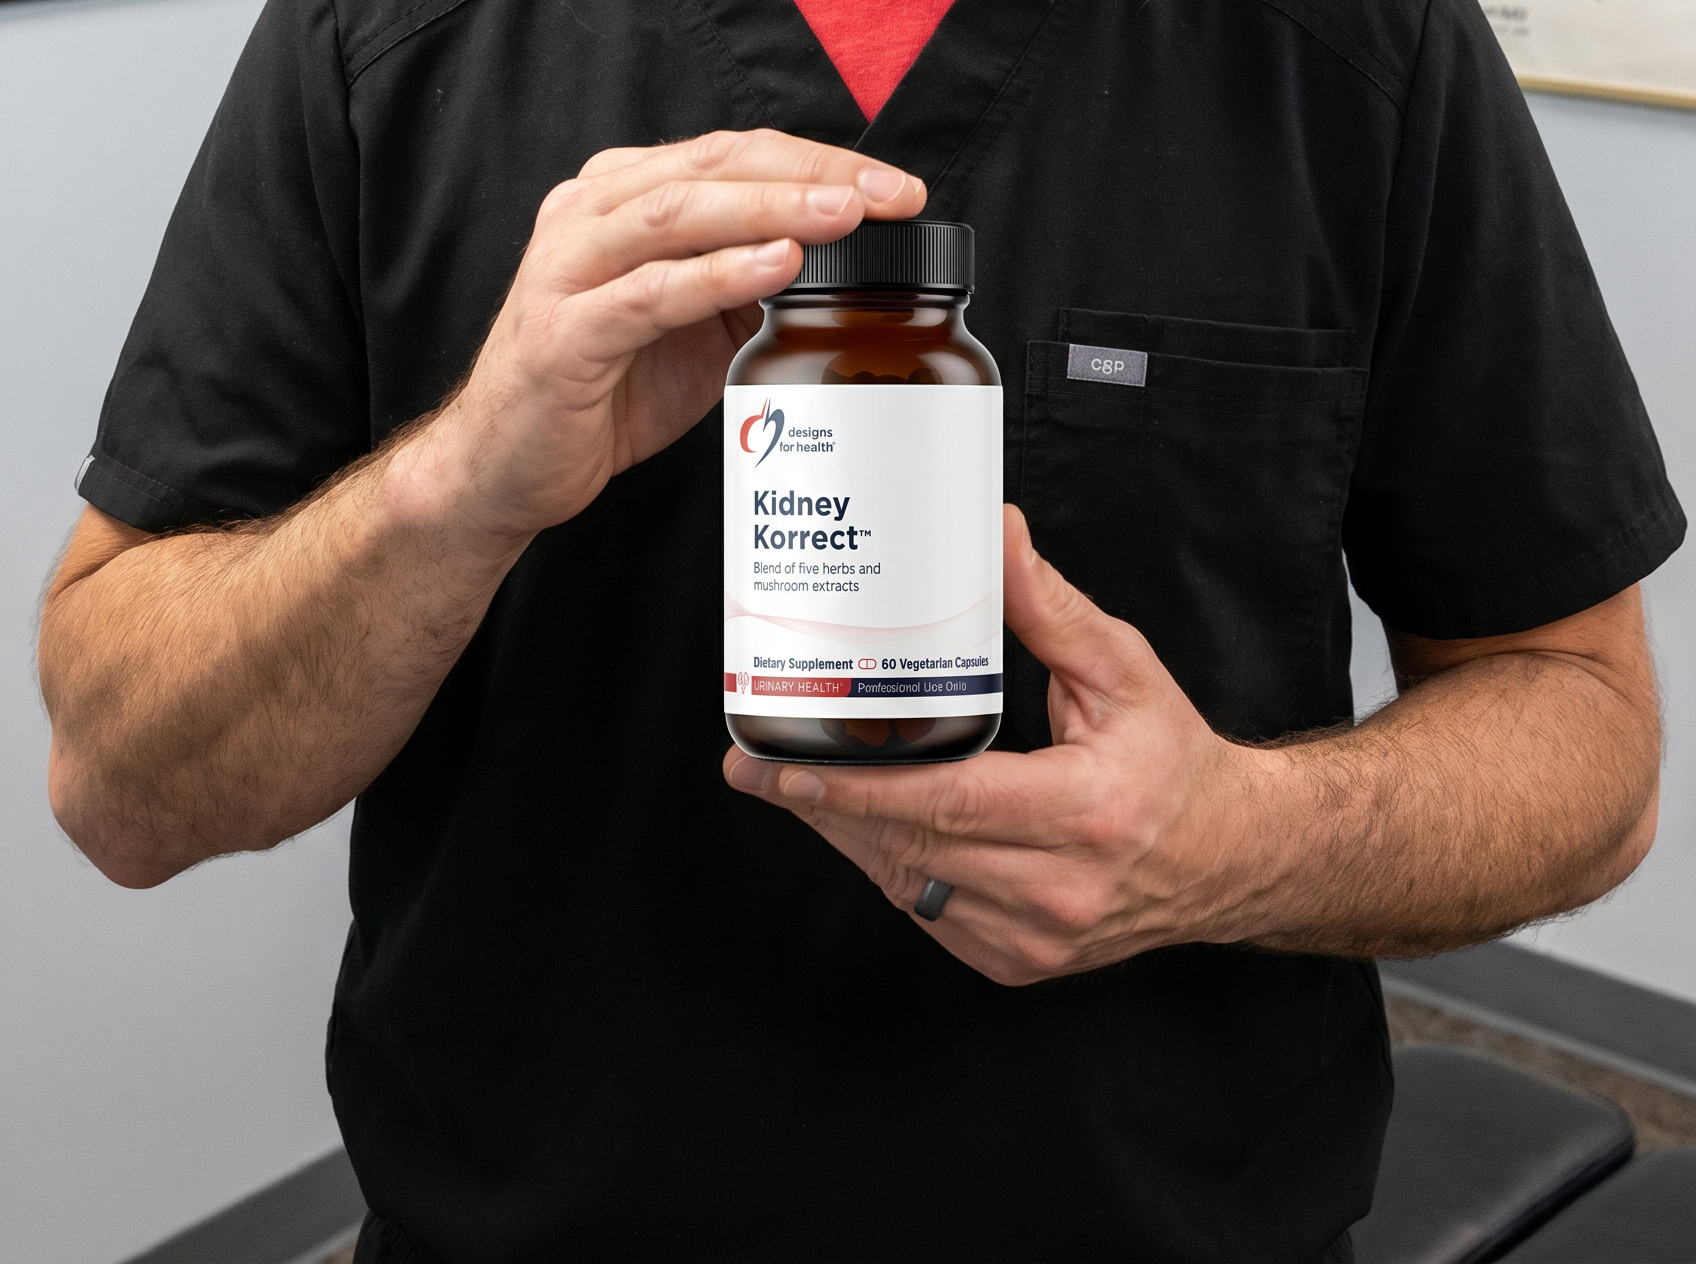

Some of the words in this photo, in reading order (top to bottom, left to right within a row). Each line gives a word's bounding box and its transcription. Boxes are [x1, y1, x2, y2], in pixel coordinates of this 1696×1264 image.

[788, 426, 833, 440] designs
[779, 441, 795, 453] for
[754, 490, 851, 521] Kidney
[753, 561, 782, 575] Blend
[784, 561, 796, 575] of
[798, 561, 820, 575] five
[822, 561, 856, 575] herbs
[858, 561, 881, 575] and
[753, 579, 809, 592] mushroom
[812, 579, 860, 592] extracts
[753, 656, 786, 671] Dietary
[788, 657, 854, 672] Supplement
[881, 657, 896, 670] 60
[753, 680, 794, 694] URINARY
